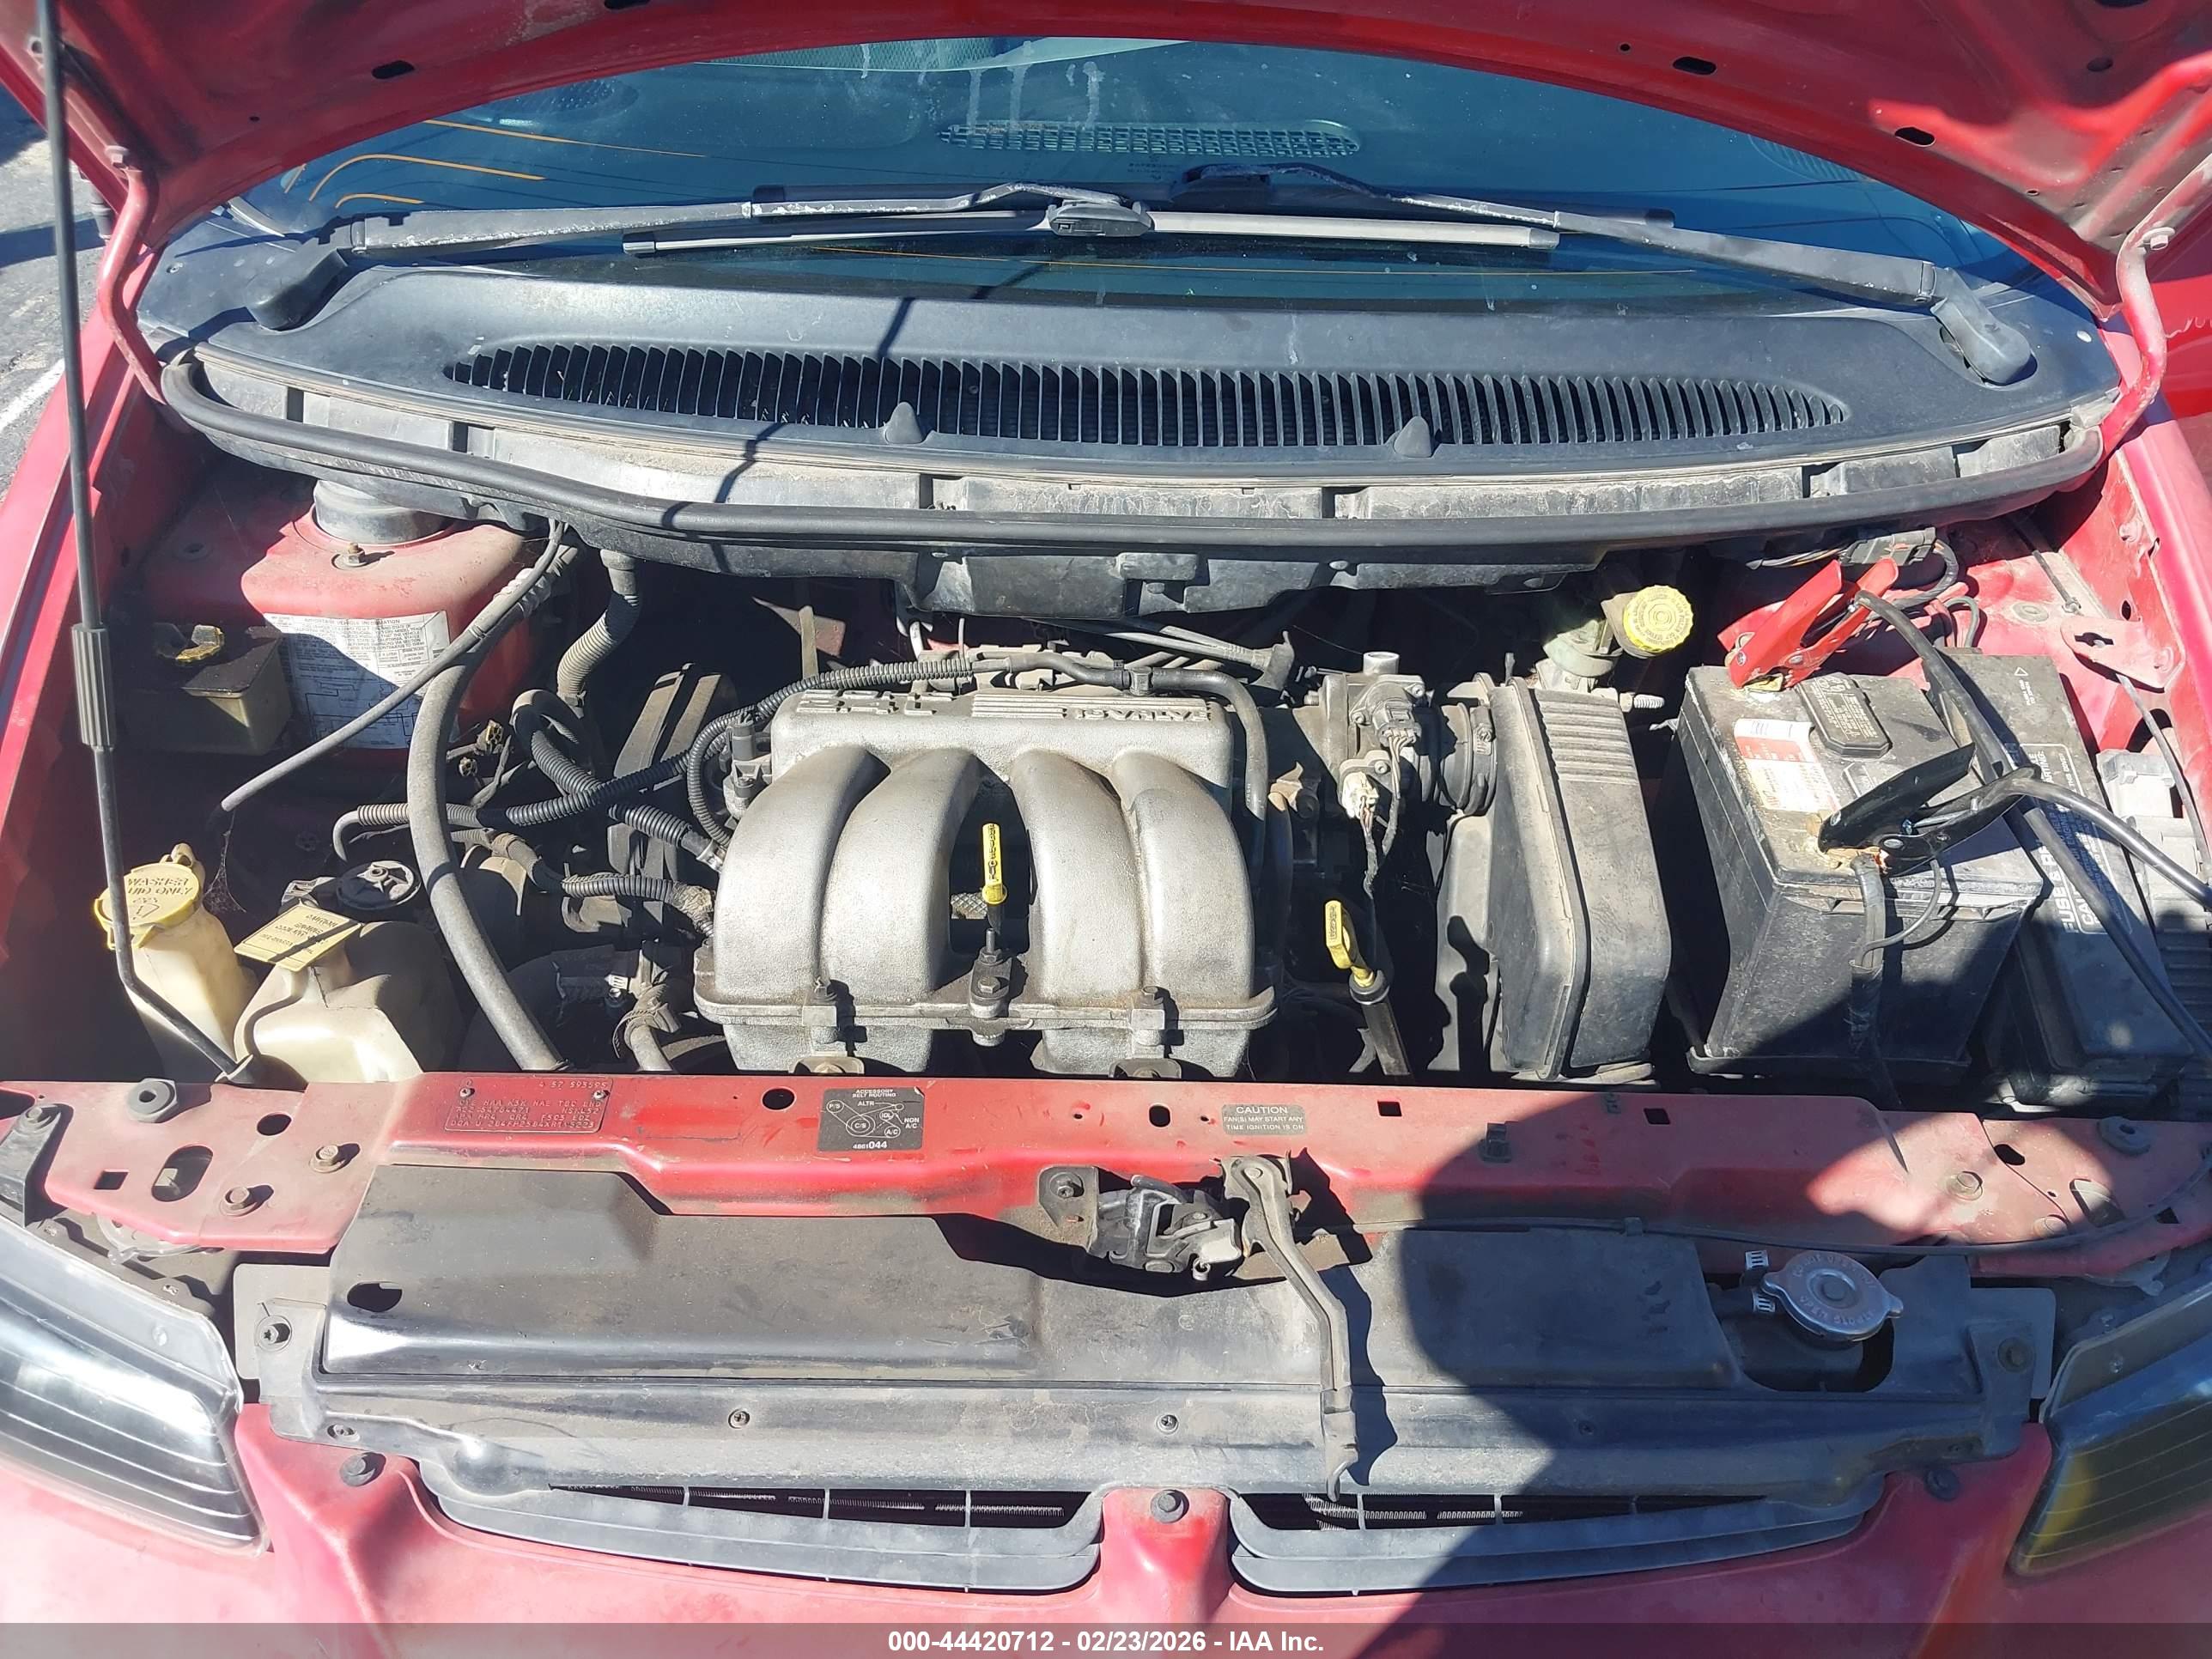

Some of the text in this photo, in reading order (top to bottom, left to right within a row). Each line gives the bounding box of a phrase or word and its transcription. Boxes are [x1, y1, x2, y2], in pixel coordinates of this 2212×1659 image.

[127, 878, 189, 886] WASHER
[155, 886, 193, 895] ONLY
[2048, 870, 2080, 933] FUSE &
